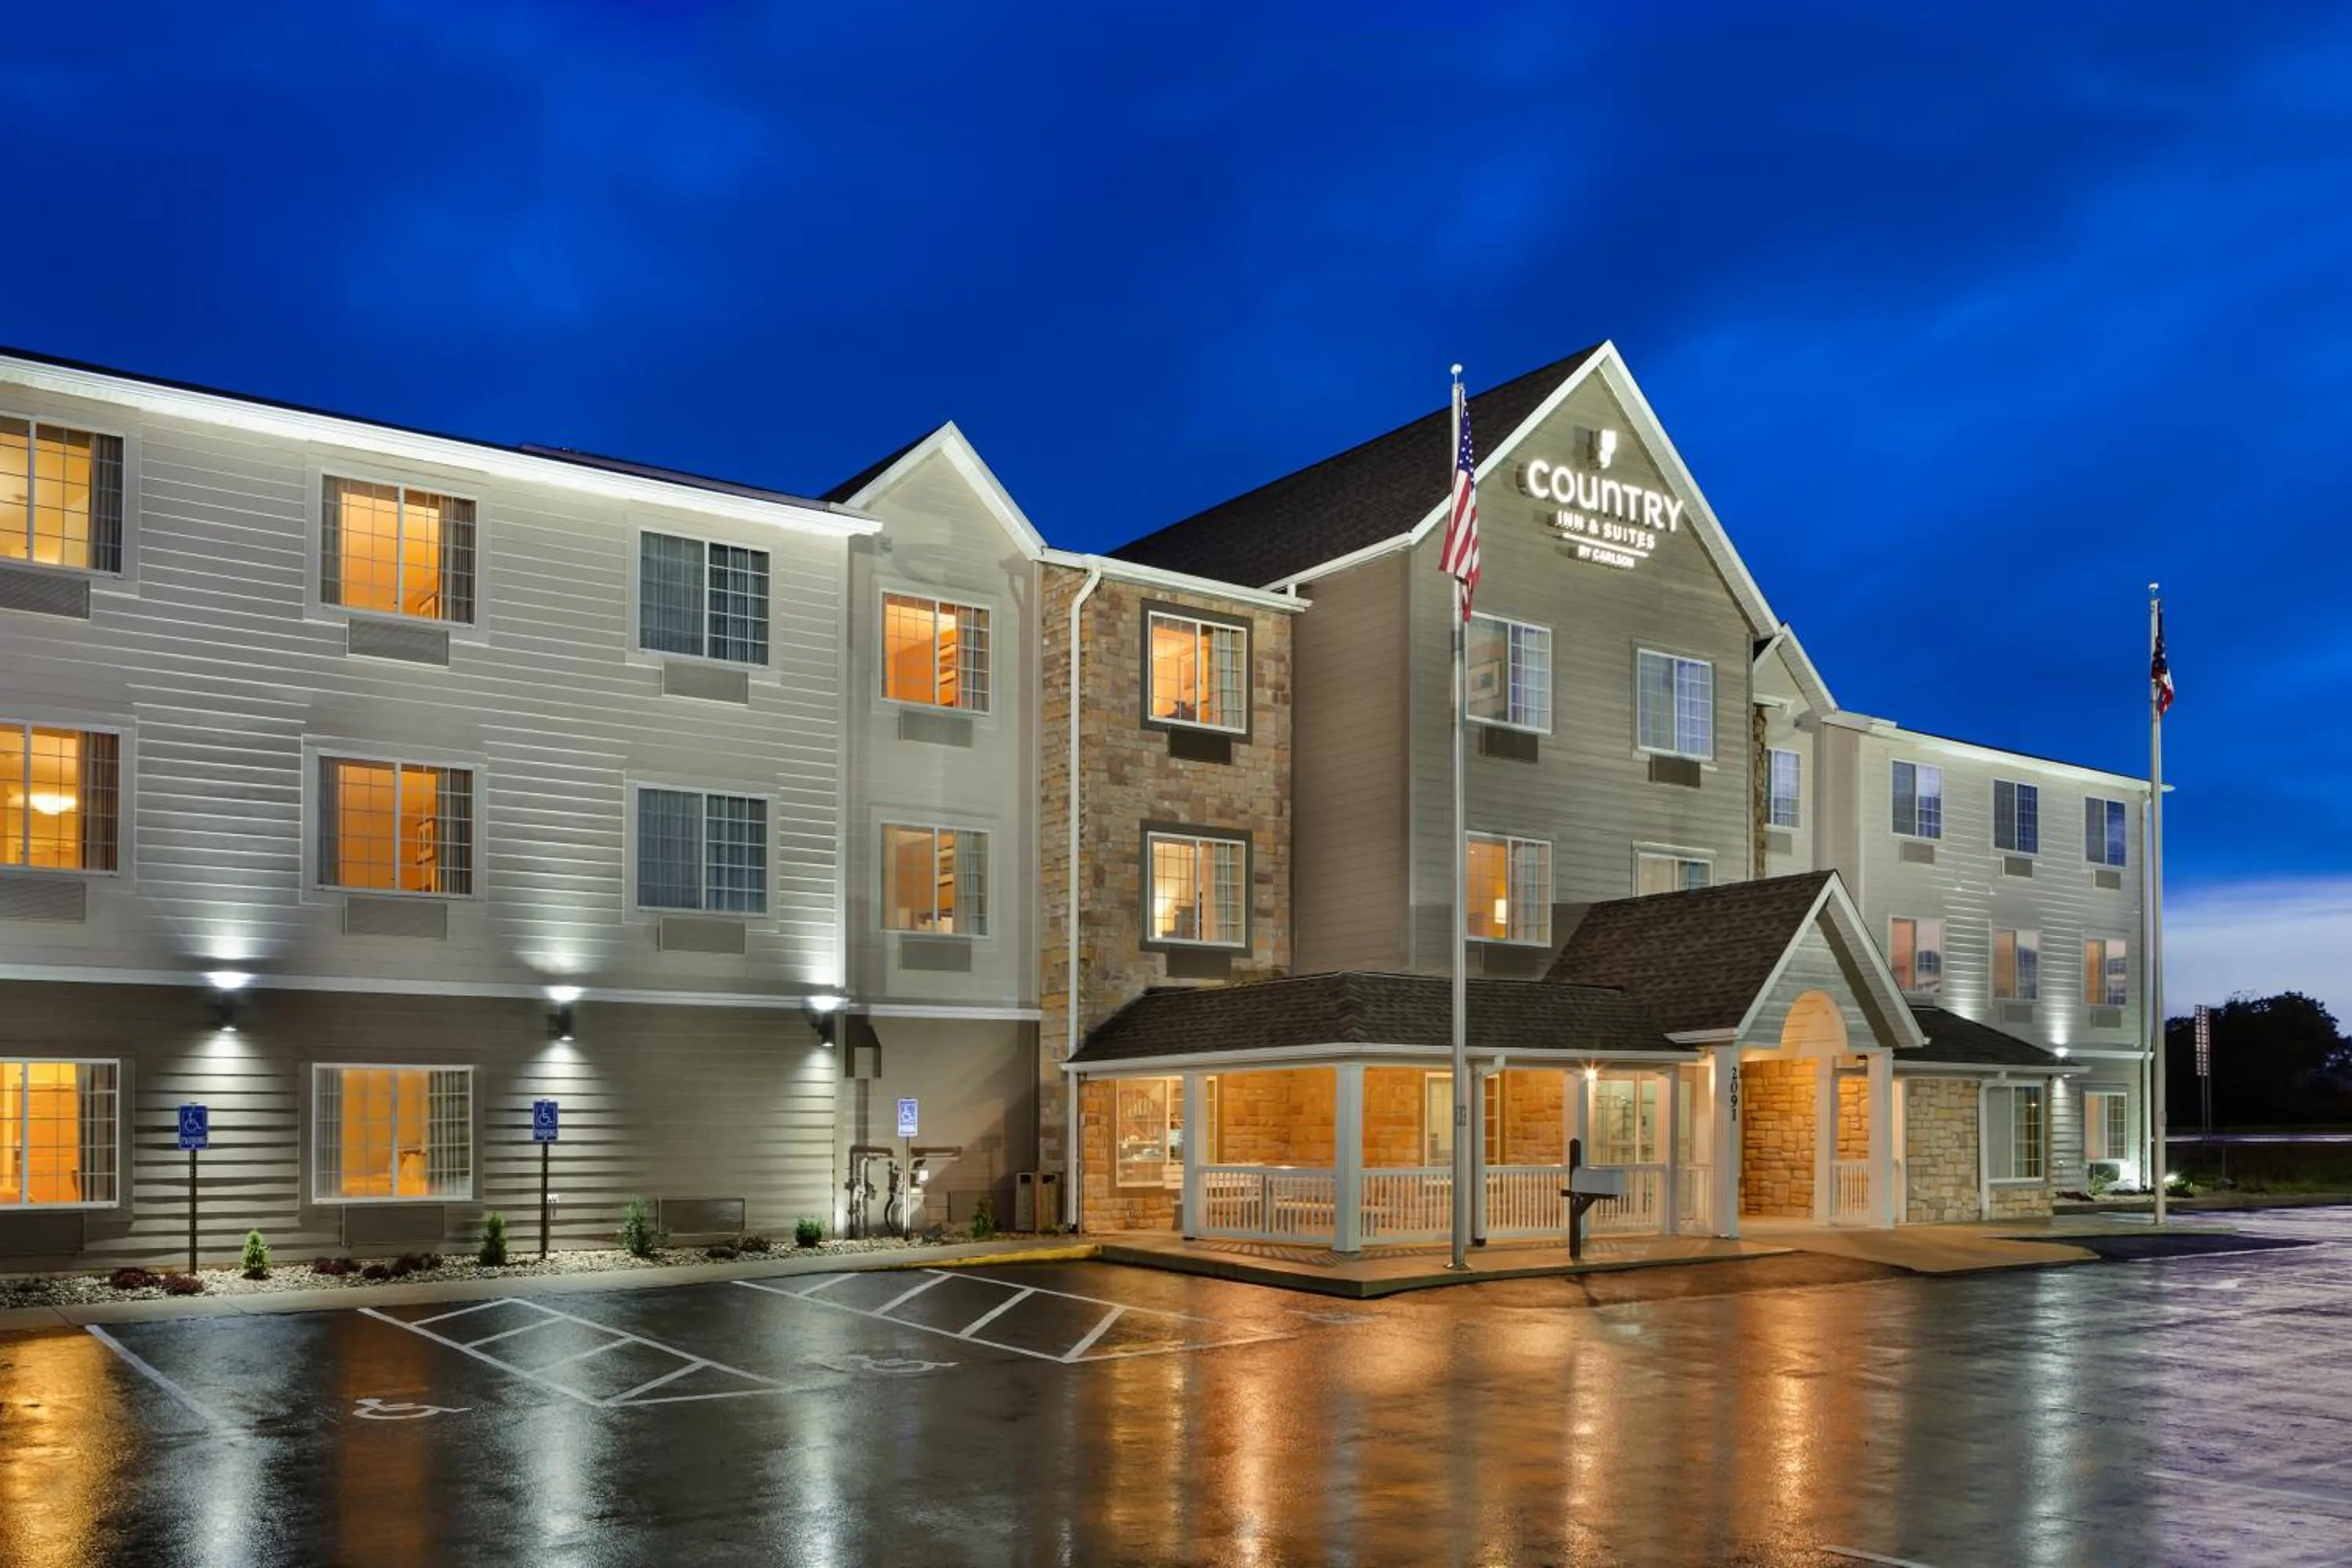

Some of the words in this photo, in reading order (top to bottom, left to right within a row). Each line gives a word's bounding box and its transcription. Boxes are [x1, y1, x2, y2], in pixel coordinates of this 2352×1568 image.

[1527, 459, 1683, 532] COUNTRY
[1556, 510, 1584, 531] INN
[1588, 519, 1599, 535] &
[1603, 522, 1655, 550] SUITES
